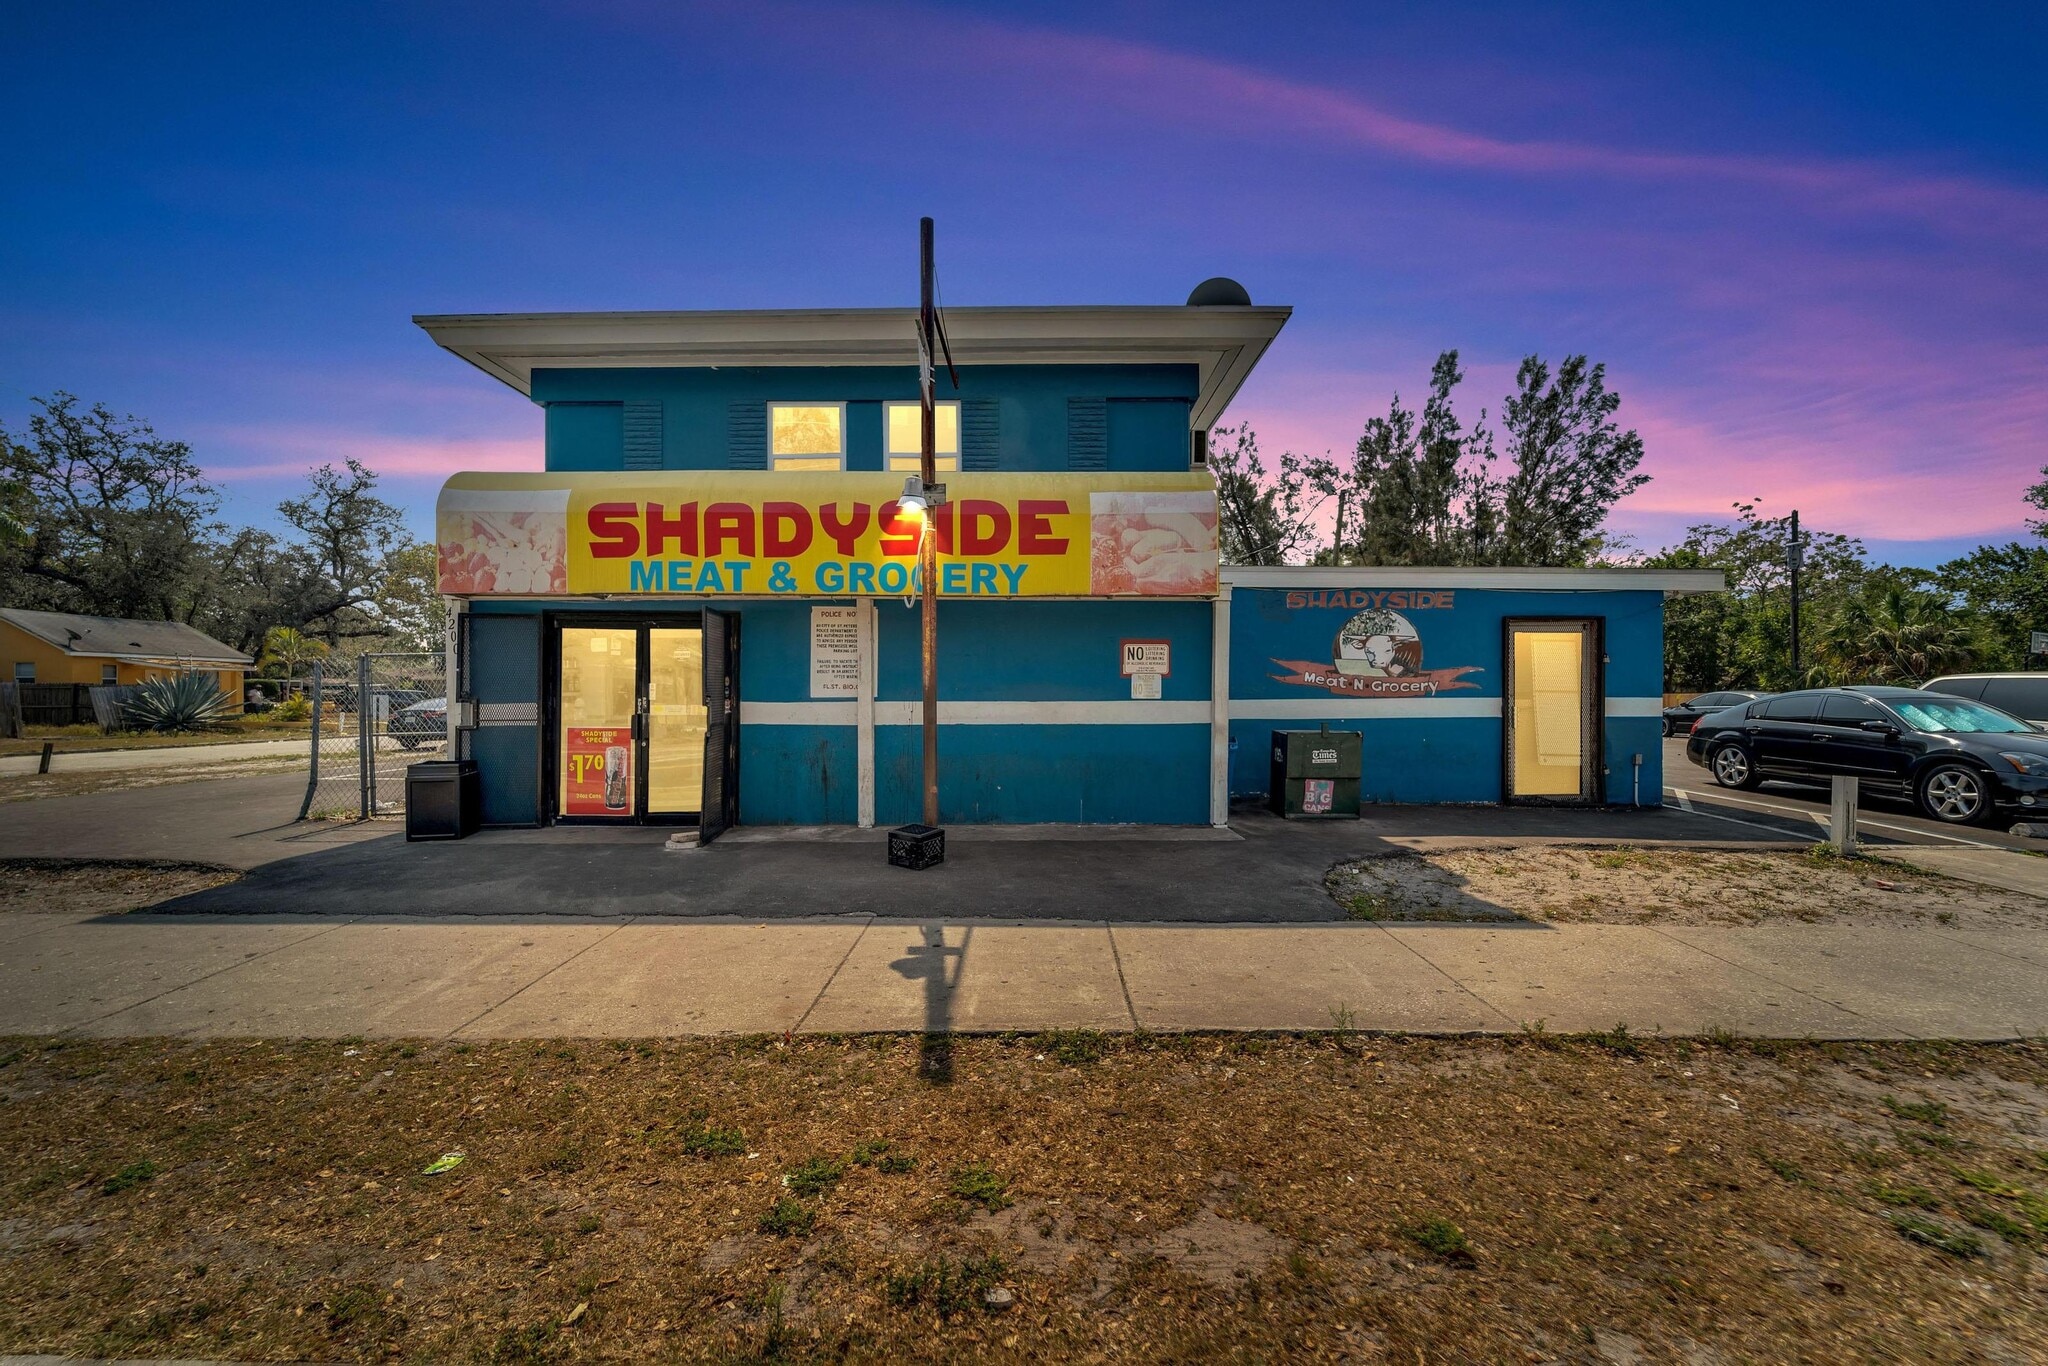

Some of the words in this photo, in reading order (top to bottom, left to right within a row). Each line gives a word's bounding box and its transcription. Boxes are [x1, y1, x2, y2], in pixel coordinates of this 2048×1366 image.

[587, 500, 1070, 559] SHADYSIDE
[630, 561, 750, 592] MEAT
[768, 561, 798, 592] &
[1286, 591, 1455, 609] SHADYSIDE
[1127, 646, 1144, 660] NO
[1304, 671, 1352, 689] Meat
[1353, 678, 1365, 691] N
[1371, 680, 1439, 696] Grocery
[1312, 750, 1337, 760] Times
